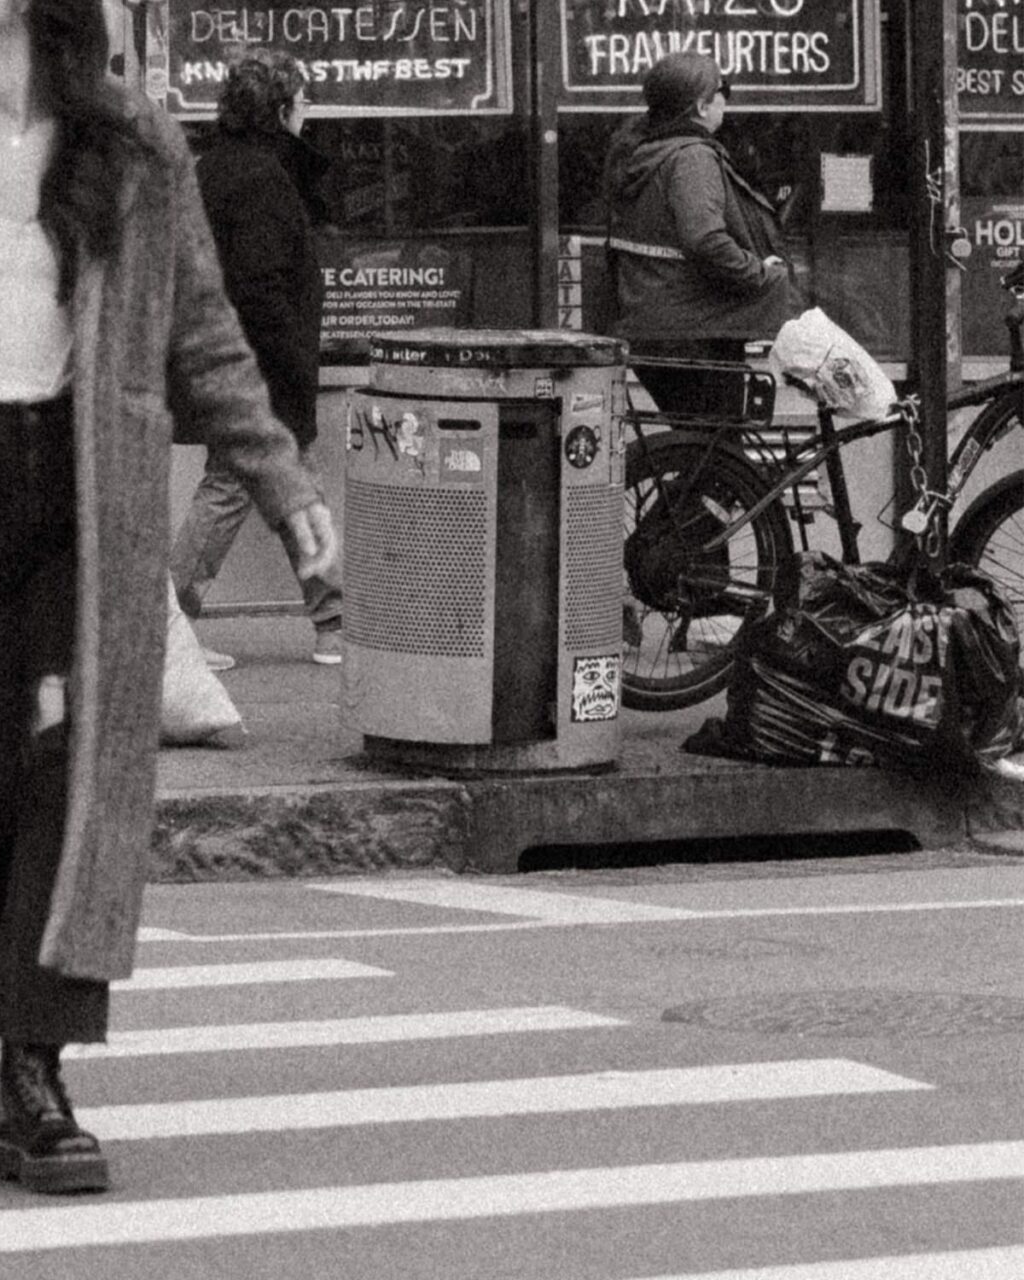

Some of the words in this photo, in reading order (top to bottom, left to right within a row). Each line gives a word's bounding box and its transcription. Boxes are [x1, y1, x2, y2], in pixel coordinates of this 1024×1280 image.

[190, 7, 478, 42] DELICATESSEN
[395, 58, 471, 80] BEST
[956, 68, 1005, 95] BEST
[339, 267, 445, 287] CATERING!
[378, 291, 395, 299] YOU
[396, 291, 420, 299] KNOW
[840, 656, 944, 728] SIDE
